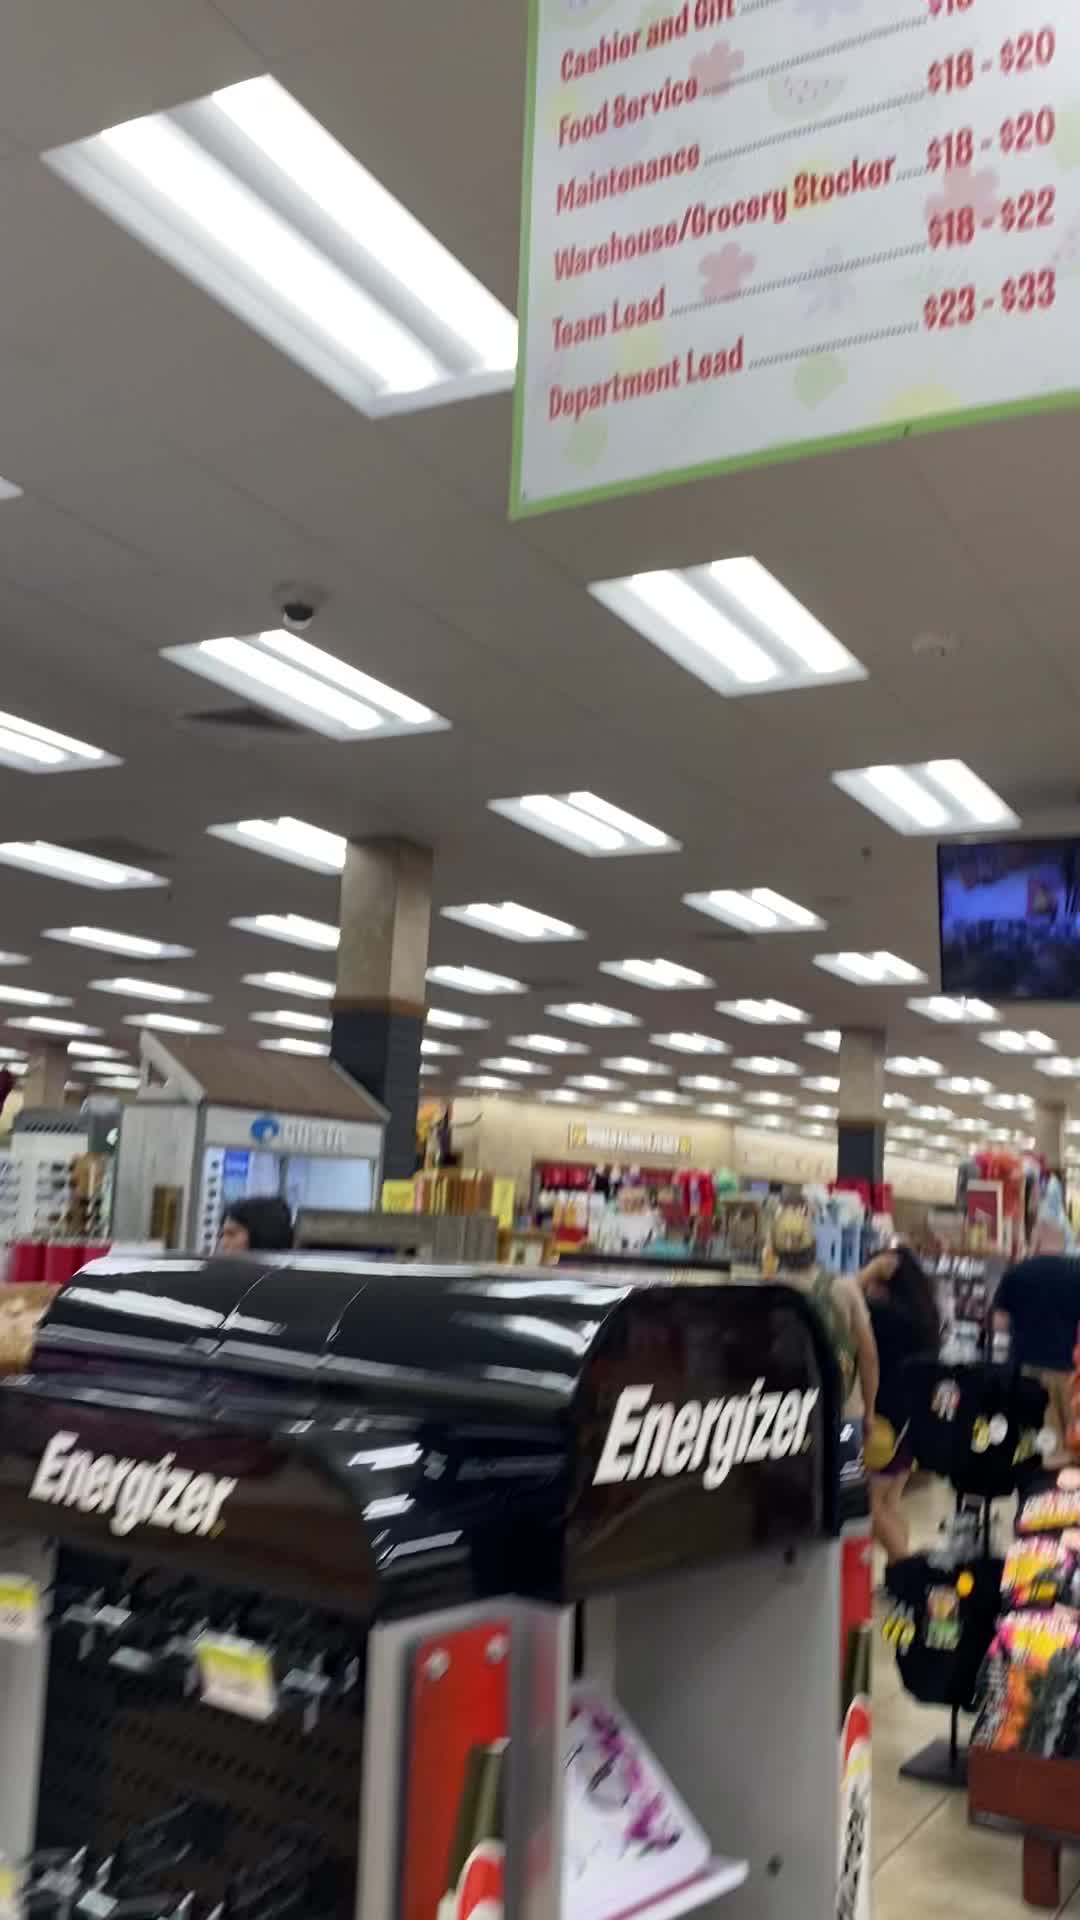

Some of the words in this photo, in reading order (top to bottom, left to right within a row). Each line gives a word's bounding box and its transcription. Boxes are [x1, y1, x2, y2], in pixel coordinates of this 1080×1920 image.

[561, 29, 641, 83] Cashier
[646, 1, 688, 47] and
[694, 0, 735, 32] Gift
[556, 144, 700, 214] Maintenance
[928, 48, 973, 95] $18
[1000, 26, 1055, 75] $20
[560, 101, 608, 148] Food
[613, 78, 698, 128] Service
[555, 188, 787, 280] Warehouse/Grocery
[794, 155, 896, 210] Stocker
[927, 125, 973, 173] $18
[1000, 105, 1055, 153] $20
[552, 312, 606, 350] Team
[612, 284, 666, 332] Lead
[928, 204, 974, 249] $18
[1001, 185, 1055, 232] $22
[549, 357, 681, 421] Department
[686, 336, 744, 384] Lead
[924, 282, 974, 330] $23
[1001, 267, 1055, 313] $33
[28, 1430, 239, 1537] Energizer
[592, 1376, 820, 1490] Energizer
